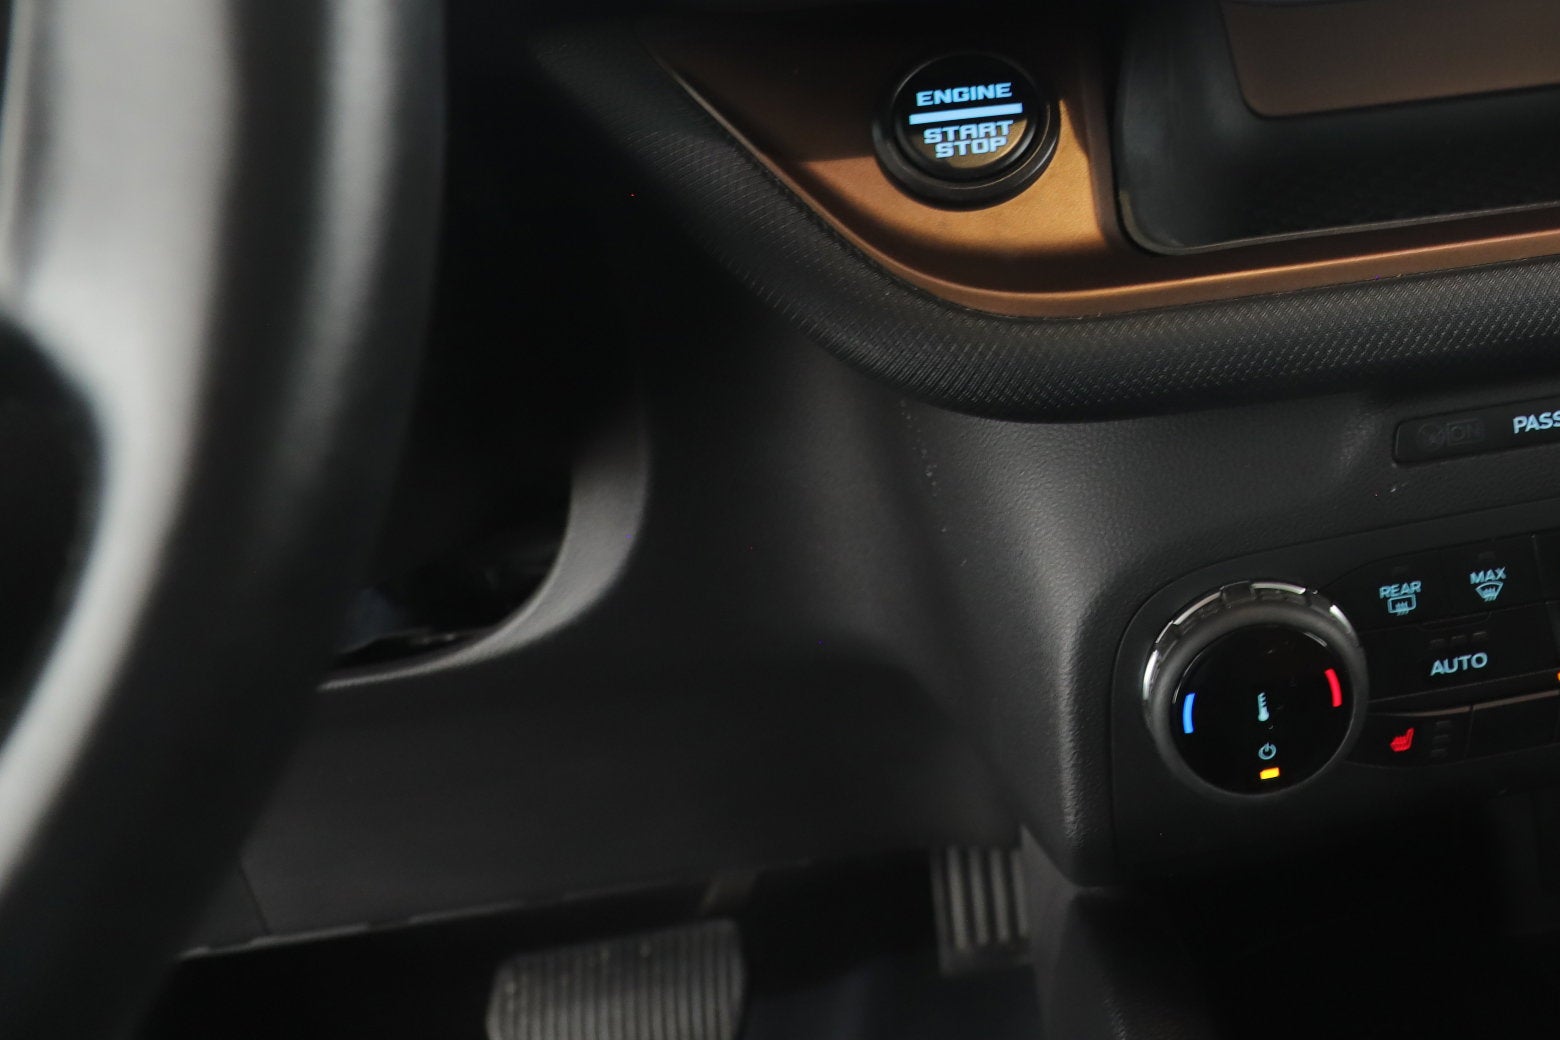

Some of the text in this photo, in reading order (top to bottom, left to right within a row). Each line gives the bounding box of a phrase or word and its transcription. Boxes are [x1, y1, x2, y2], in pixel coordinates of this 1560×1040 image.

[915, 82, 1013, 107] ENGINE
[923, 120, 1014, 144] START
[935, 136, 1008, 159] STOP
[1469, 566, 1507, 584] MAX
[1379, 579, 1422, 599] REAR
[1430, 651, 1489, 677] AUTO
